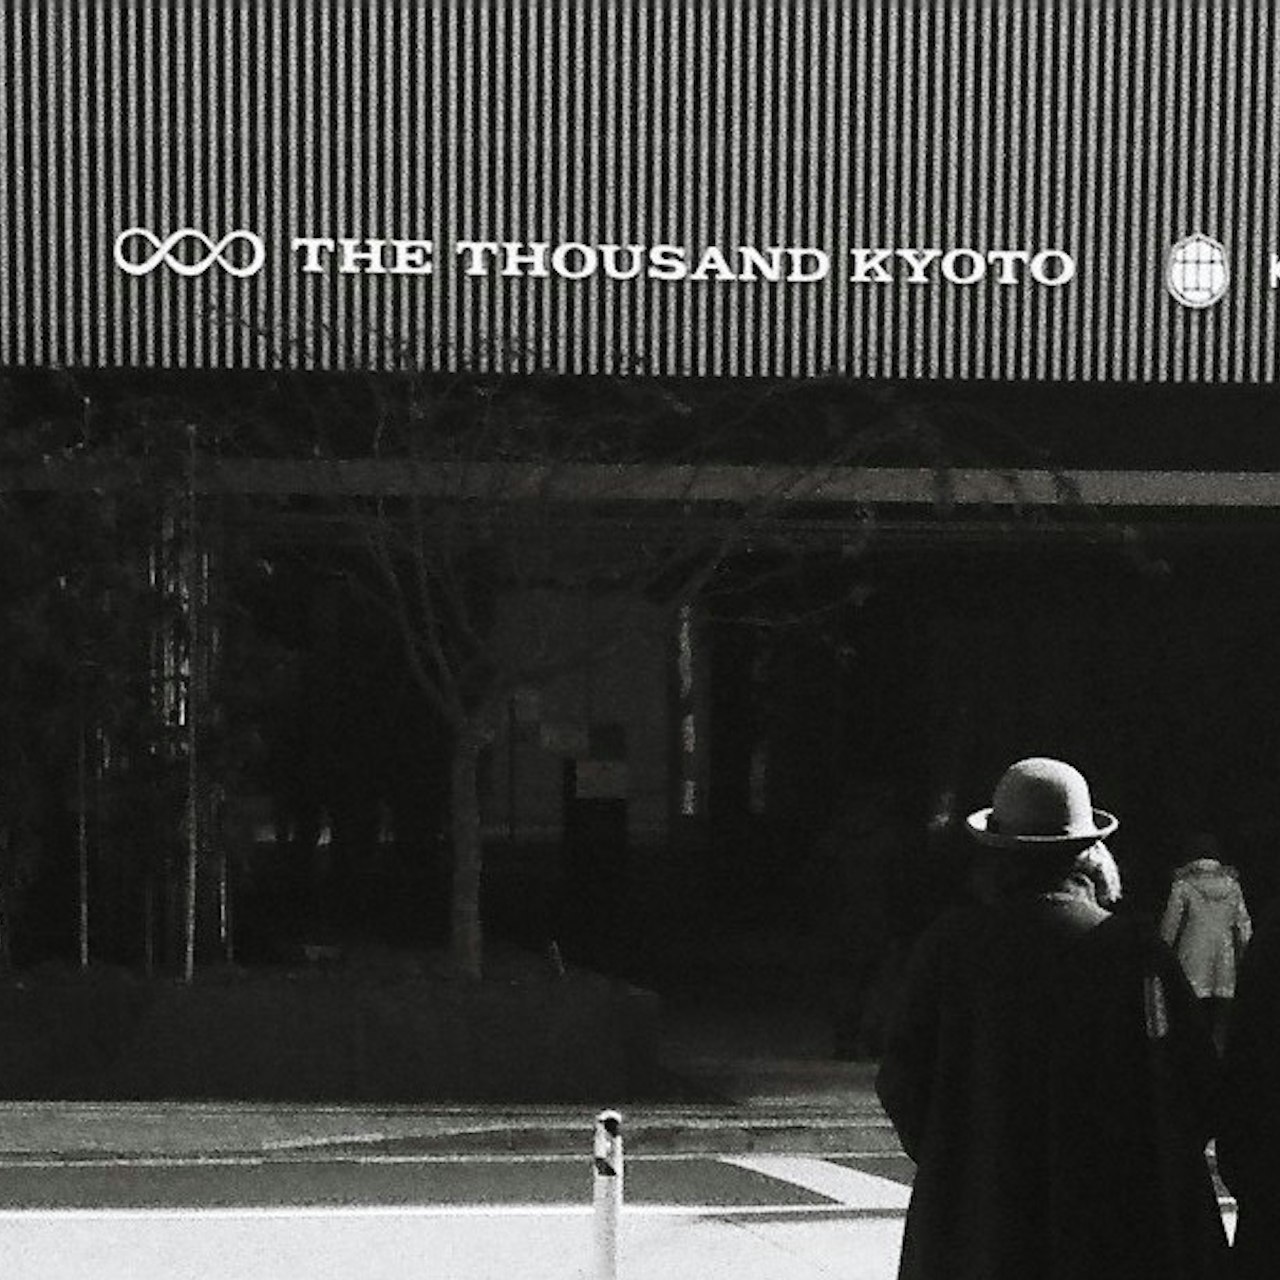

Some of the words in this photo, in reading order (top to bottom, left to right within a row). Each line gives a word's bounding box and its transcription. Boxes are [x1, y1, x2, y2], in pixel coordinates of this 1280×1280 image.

[290, 236, 433, 275] THE
[455, 240, 831, 282] THOUSAND
[850, 246, 1076, 286] KYOTO
